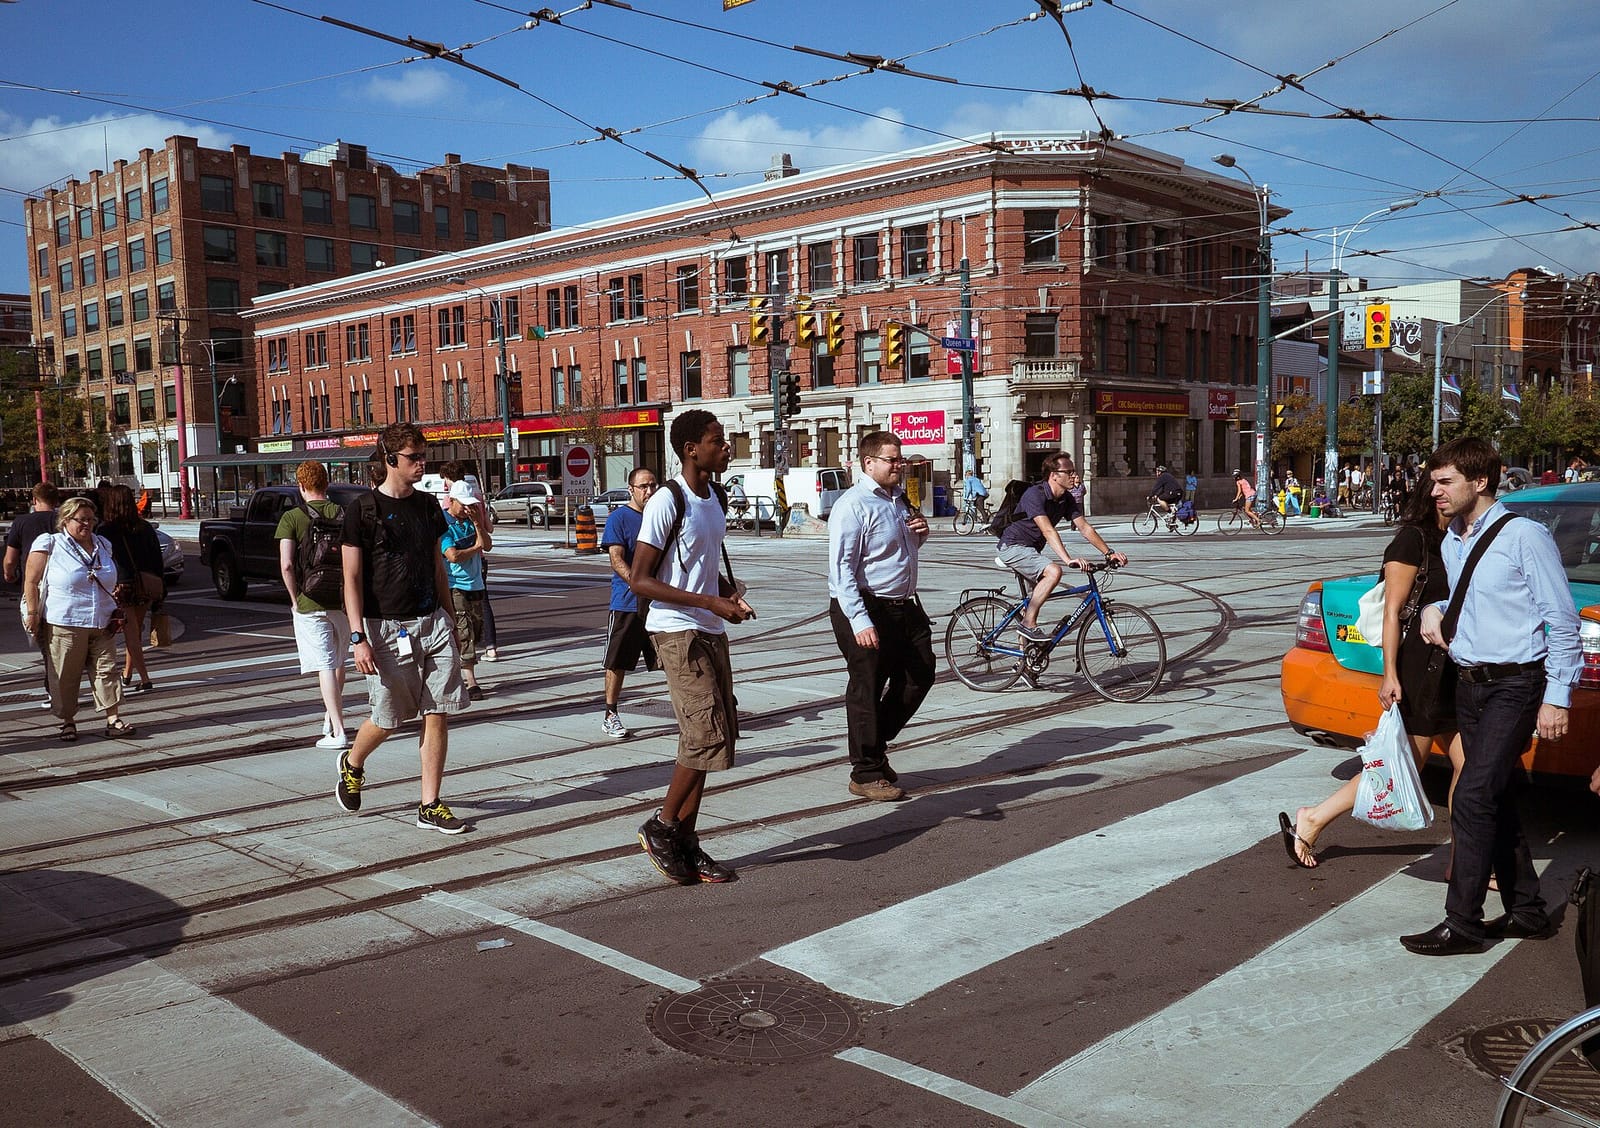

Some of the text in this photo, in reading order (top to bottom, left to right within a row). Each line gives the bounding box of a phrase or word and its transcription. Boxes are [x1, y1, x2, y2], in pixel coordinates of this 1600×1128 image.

[945, 338, 961, 348] Queen
[1217, 392, 1228, 402] Open
[907, 415, 928, 426] Open
[893, 425, 943, 441] Saturdays!
